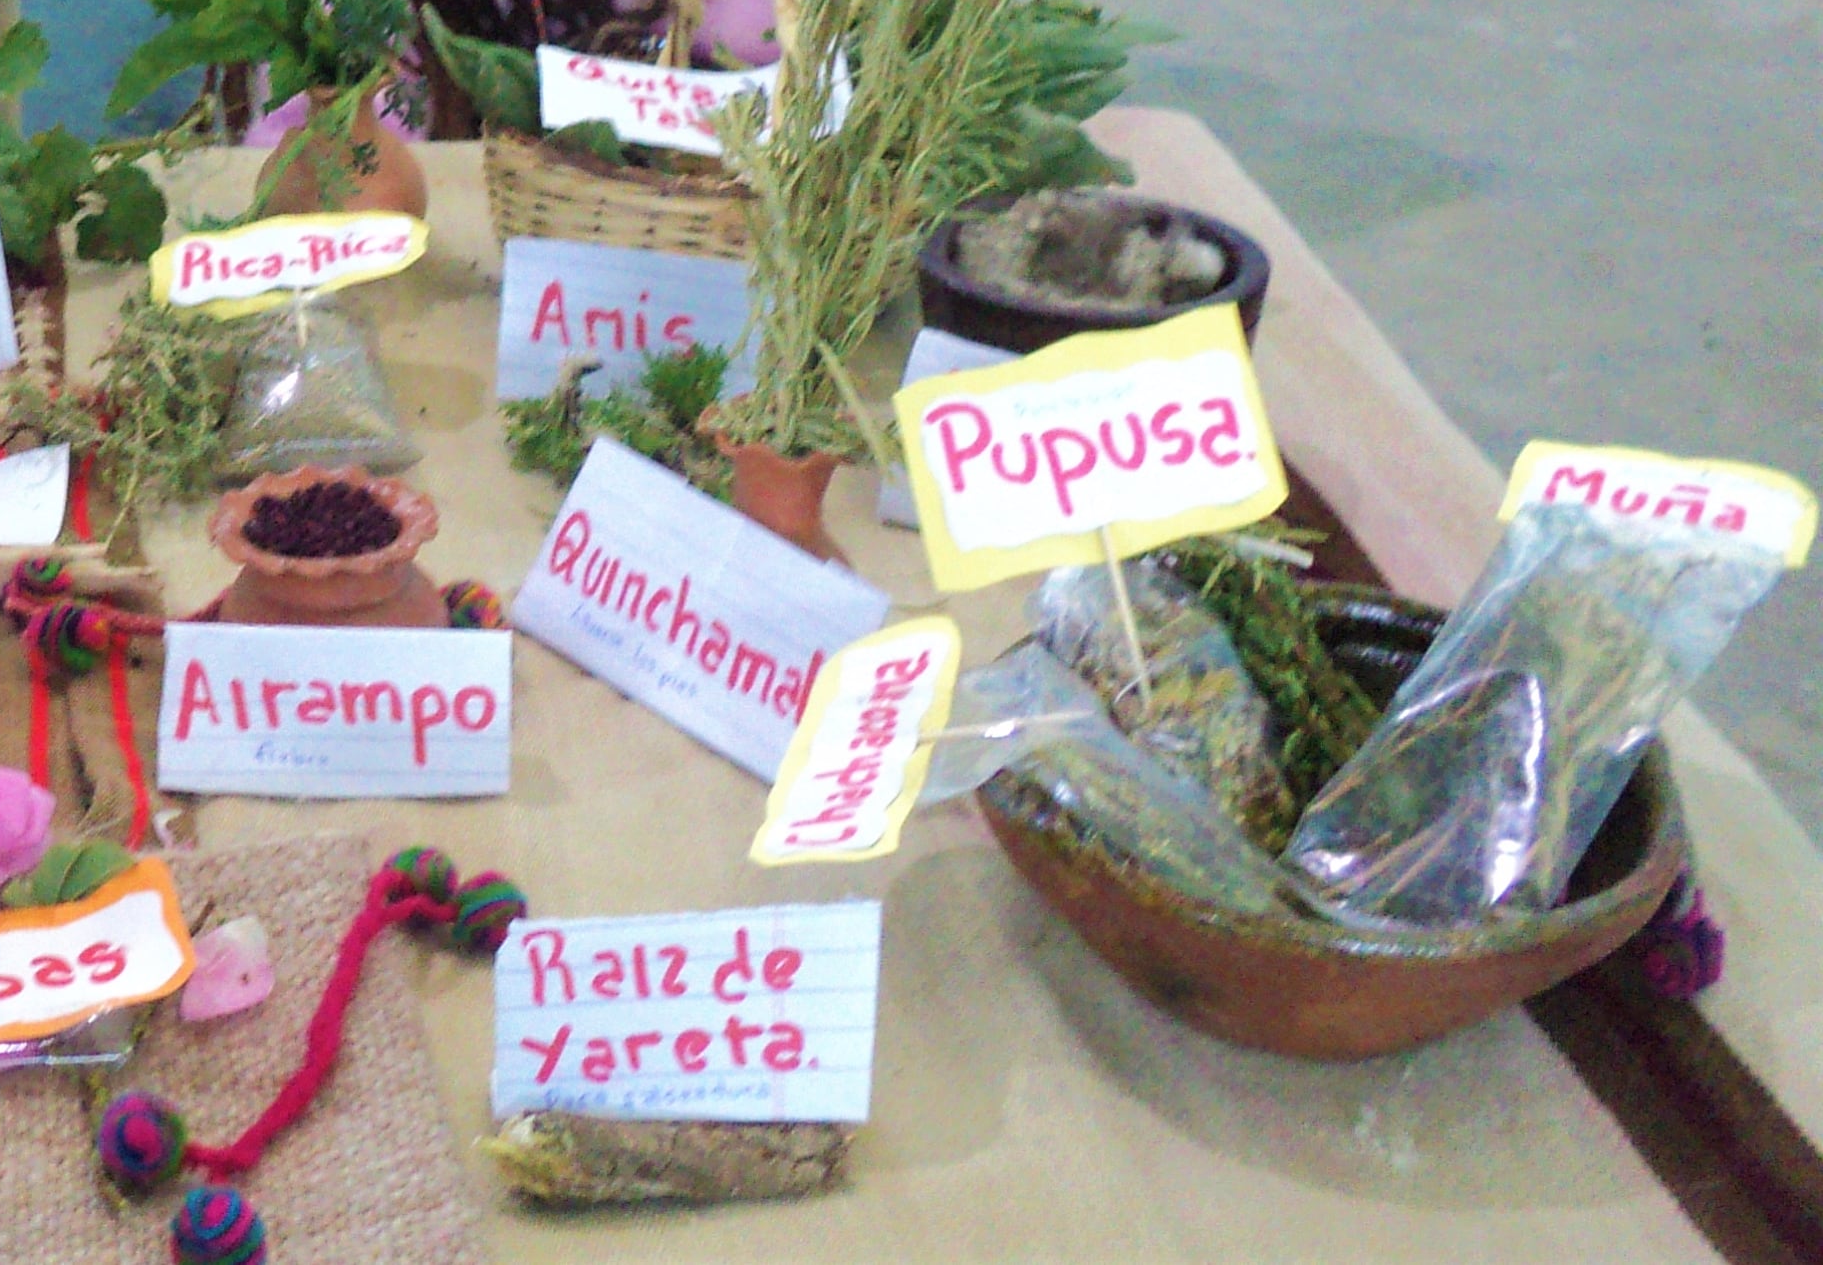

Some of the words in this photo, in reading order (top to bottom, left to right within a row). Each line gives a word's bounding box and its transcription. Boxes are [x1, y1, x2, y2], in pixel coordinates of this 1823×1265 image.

[1540, 463, 1749, 534] Muña
[172, 657, 500, 767] Airampo
[711, 924, 804, 1005] de
